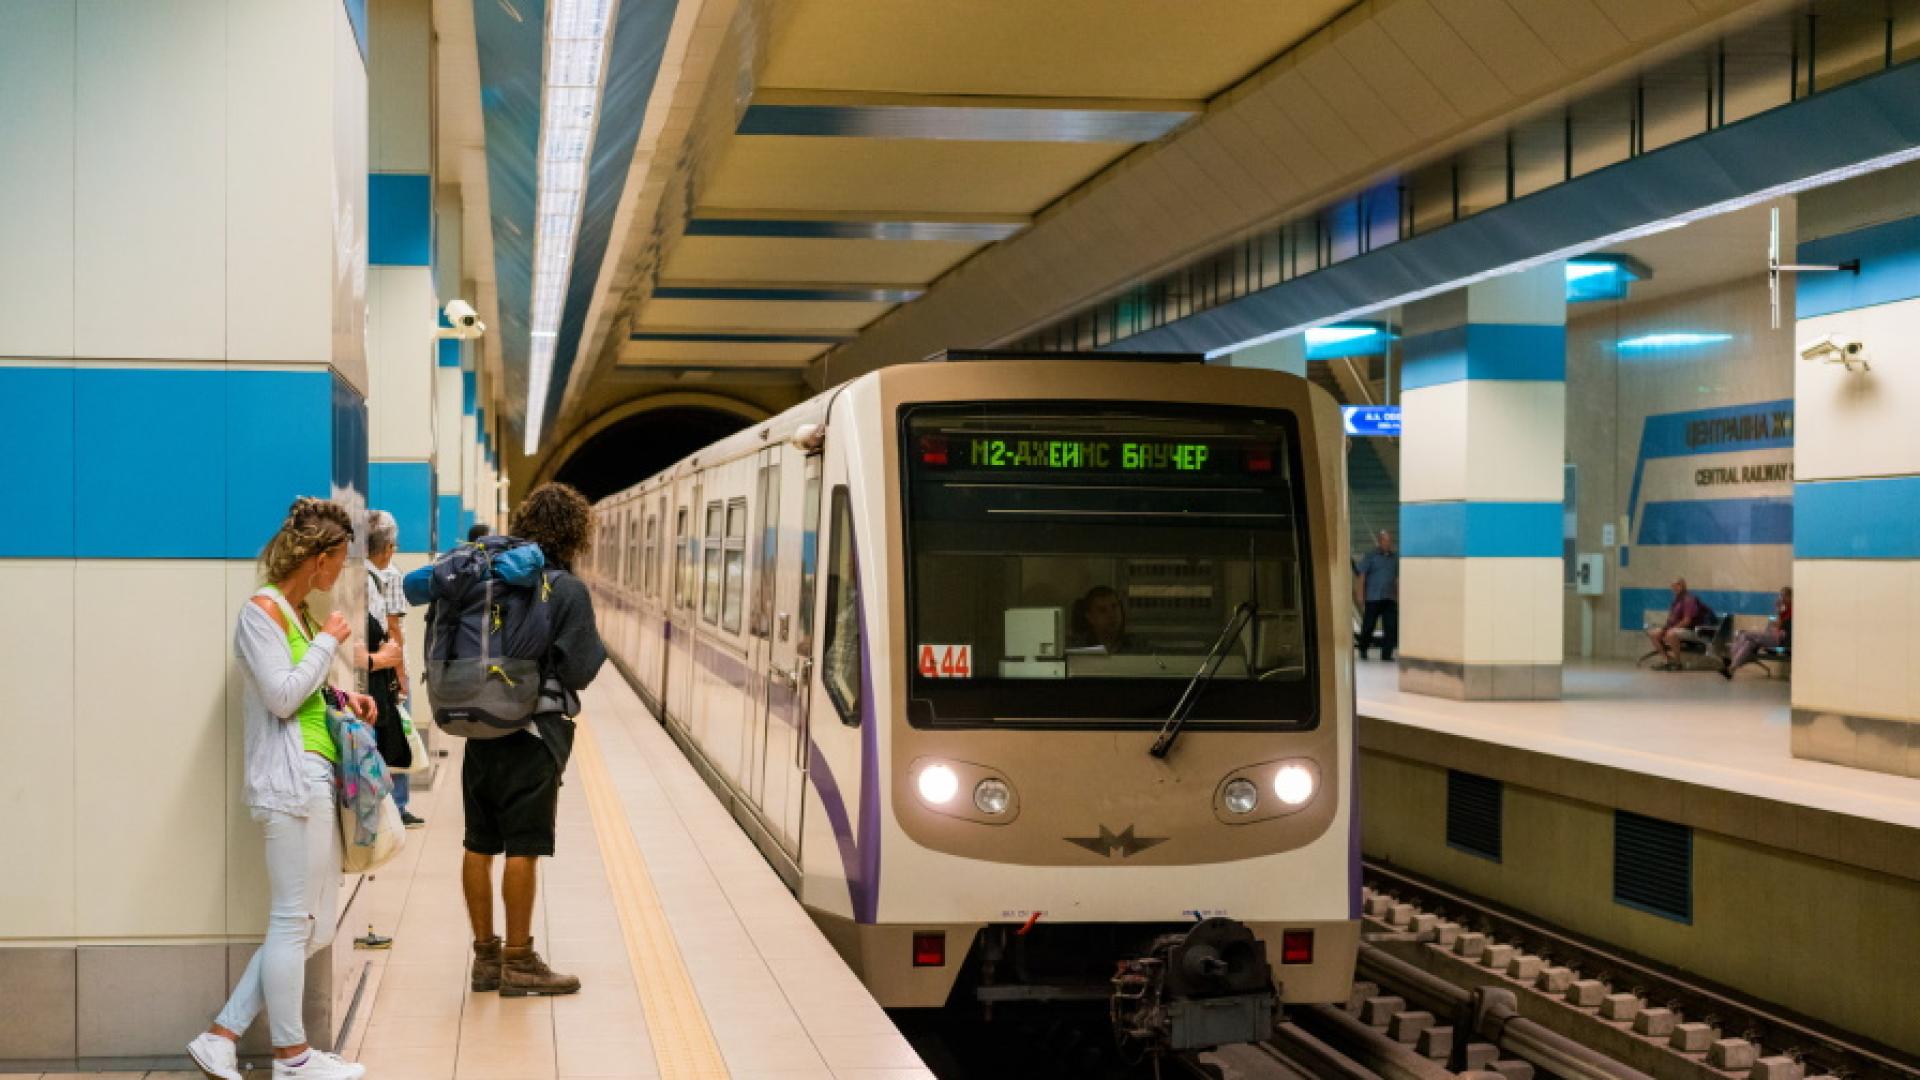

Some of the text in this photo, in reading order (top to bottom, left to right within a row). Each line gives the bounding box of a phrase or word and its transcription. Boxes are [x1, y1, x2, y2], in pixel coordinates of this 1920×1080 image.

[1122, 442, 1209, 470] БАУЧЕР
[1695, 466, 1740, 488] CENTRAL
[1742, 463, 1788, 485] RAILWAY
